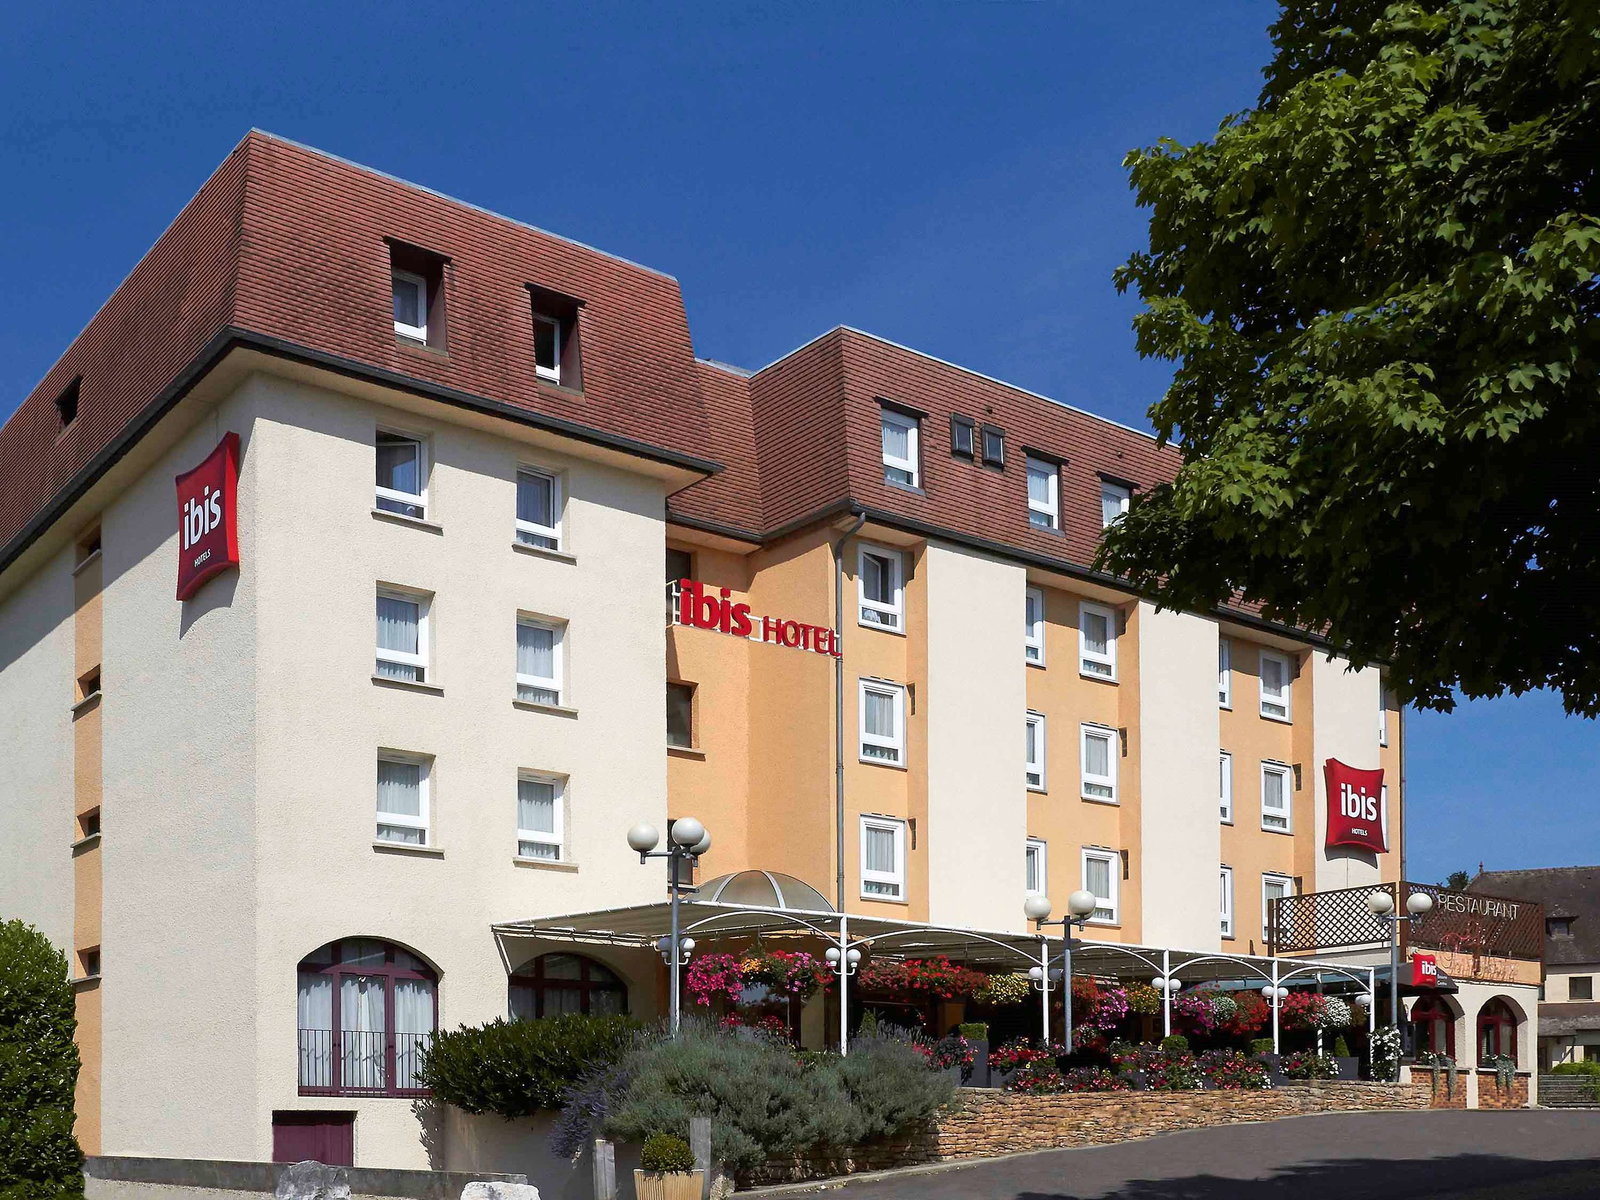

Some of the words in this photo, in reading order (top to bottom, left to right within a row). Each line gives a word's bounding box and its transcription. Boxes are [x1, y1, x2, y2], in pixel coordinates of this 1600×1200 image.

[184, 486, 222, 550] ibis
[194, 548, 211, 567] HOTELS
[680, 578, 752, 637] ibis
[763, 616, 842, 656] HOTEL
[1341, 783, 1377, 821] ibis
[1438, 894, 1520, 920] RESTAURANT
[1421, 960, 1437, 976] ibis
